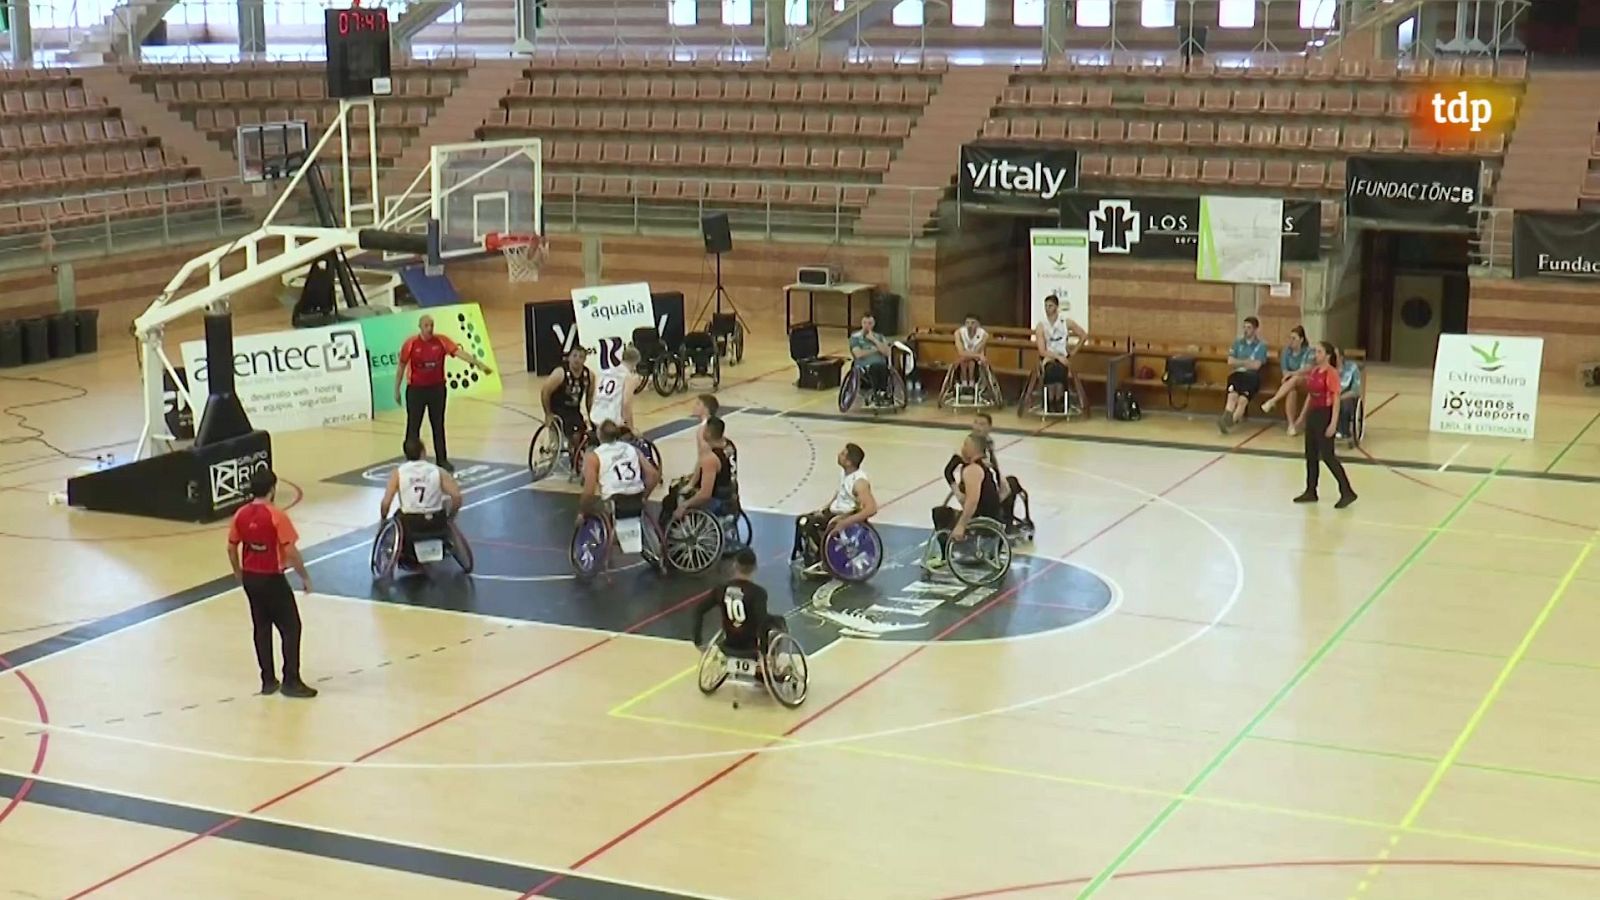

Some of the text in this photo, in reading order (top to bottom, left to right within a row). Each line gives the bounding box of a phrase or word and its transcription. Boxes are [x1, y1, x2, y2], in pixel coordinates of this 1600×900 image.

[339, 12, 386, 34] 07:47
[1150, 214, 1188, 231] LOS
[591, 301, 645, 320] aqualia
[194, 343, 320, 382] aentec
[1448, 371, 1527, 387] Extremadura
[613, 461, 636, 481] 13
[414, 486, 426, 503] 7
[724, 596, 746, 623] 10
[735, 660, 749, 671] 10
